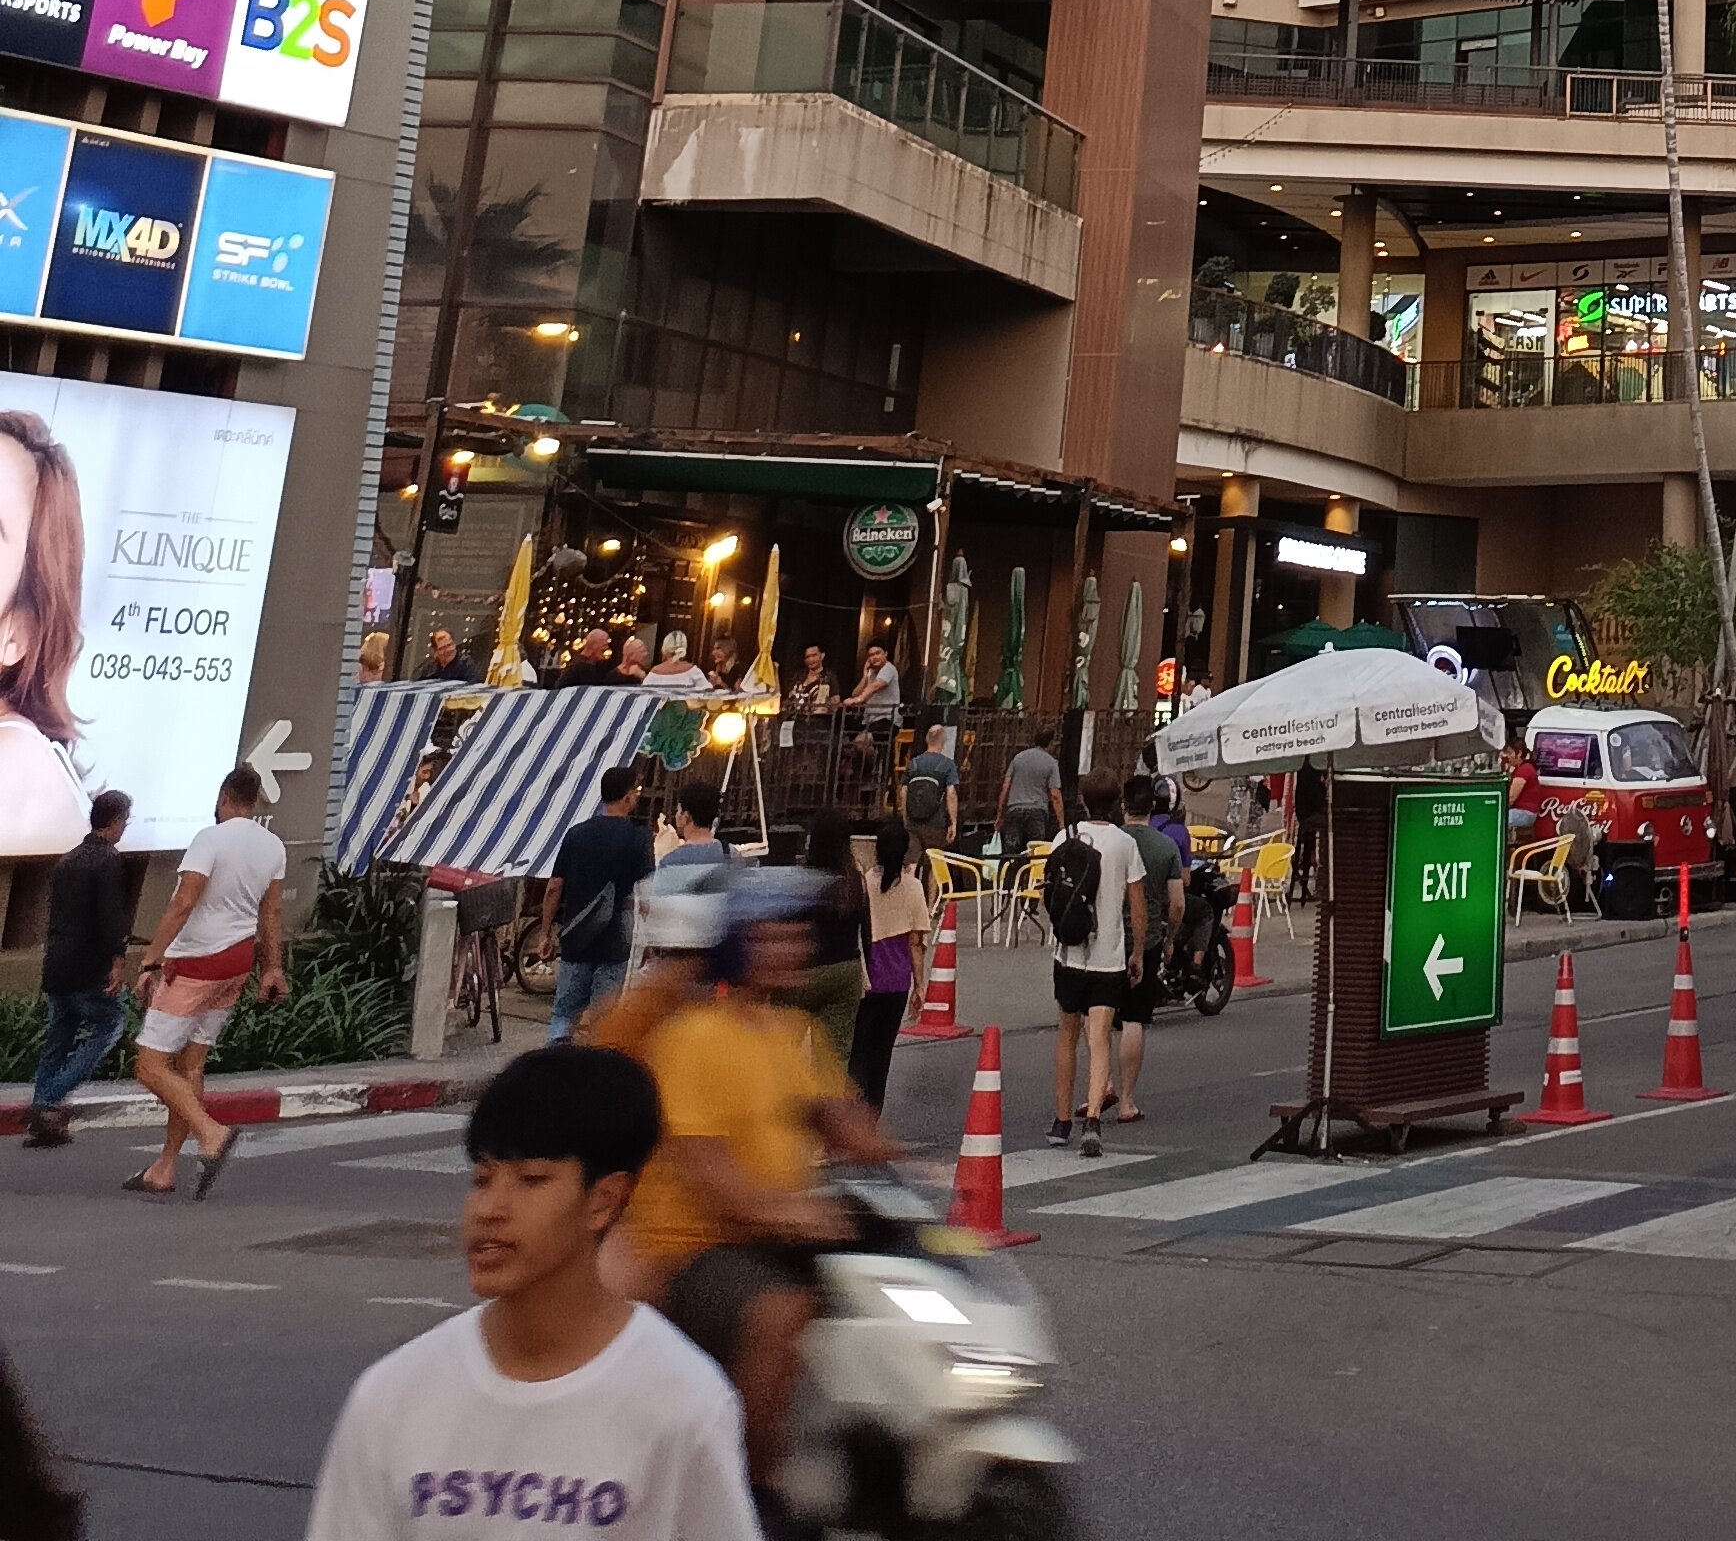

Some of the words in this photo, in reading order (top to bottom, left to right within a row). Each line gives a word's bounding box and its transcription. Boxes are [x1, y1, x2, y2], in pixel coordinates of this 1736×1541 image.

[73, 204, 180, 263] MX4D
[851, 527, 914, 543] Heineken
[110, 529, 255, 573] KLINIQUE
[145, 607, 230, 636] FLOOR
[90, 652, 233, 683] 038-043-553
[1546, 654, 1640, 699] Cocktail
[1242, 713, 1339, 740] centralfestival
[1255, 741, 1294, 756] pattaya
[1296, 734, 1327, 748] beach
[1432, 802, 1466, 815] CENTRAL
[1433, 816, 1464, 827] PATTAYA
[1422, 861, 1472, 902] EXIT
[410, 1468, 629, 1528] PSYCHO
